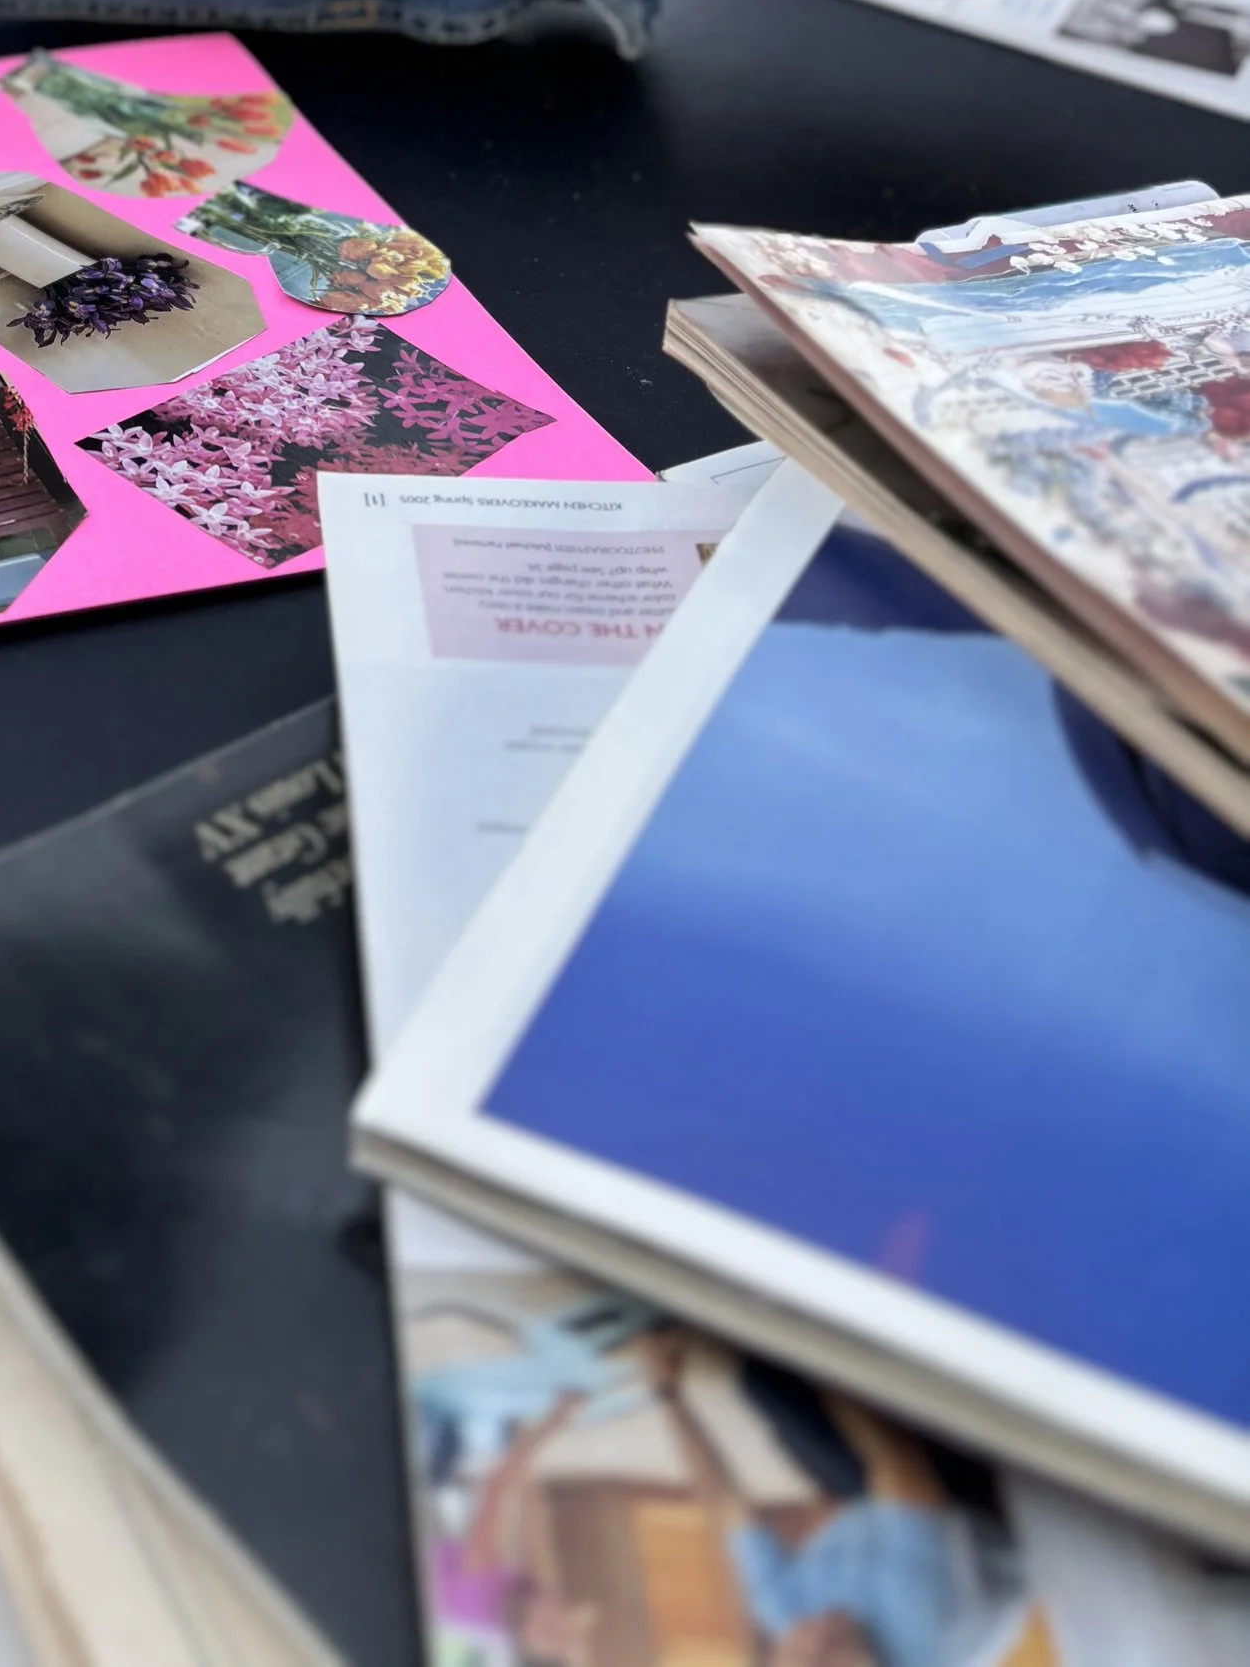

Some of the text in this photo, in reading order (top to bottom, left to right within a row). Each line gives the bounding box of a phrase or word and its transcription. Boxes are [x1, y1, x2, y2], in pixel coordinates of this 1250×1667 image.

[399, 493, 623, 512] KITCHEN MAKEOVERS Spring 2005
[595, 579, 632, 590] other
[635, 579, 673, 590] What
[563, 591, 585, 603] for
[586, 592, 639, 604] scheme
[641, 593, 677, 604] color
[494, 616, 582, 636] COVER
[586, 620, 638, 639] THE
